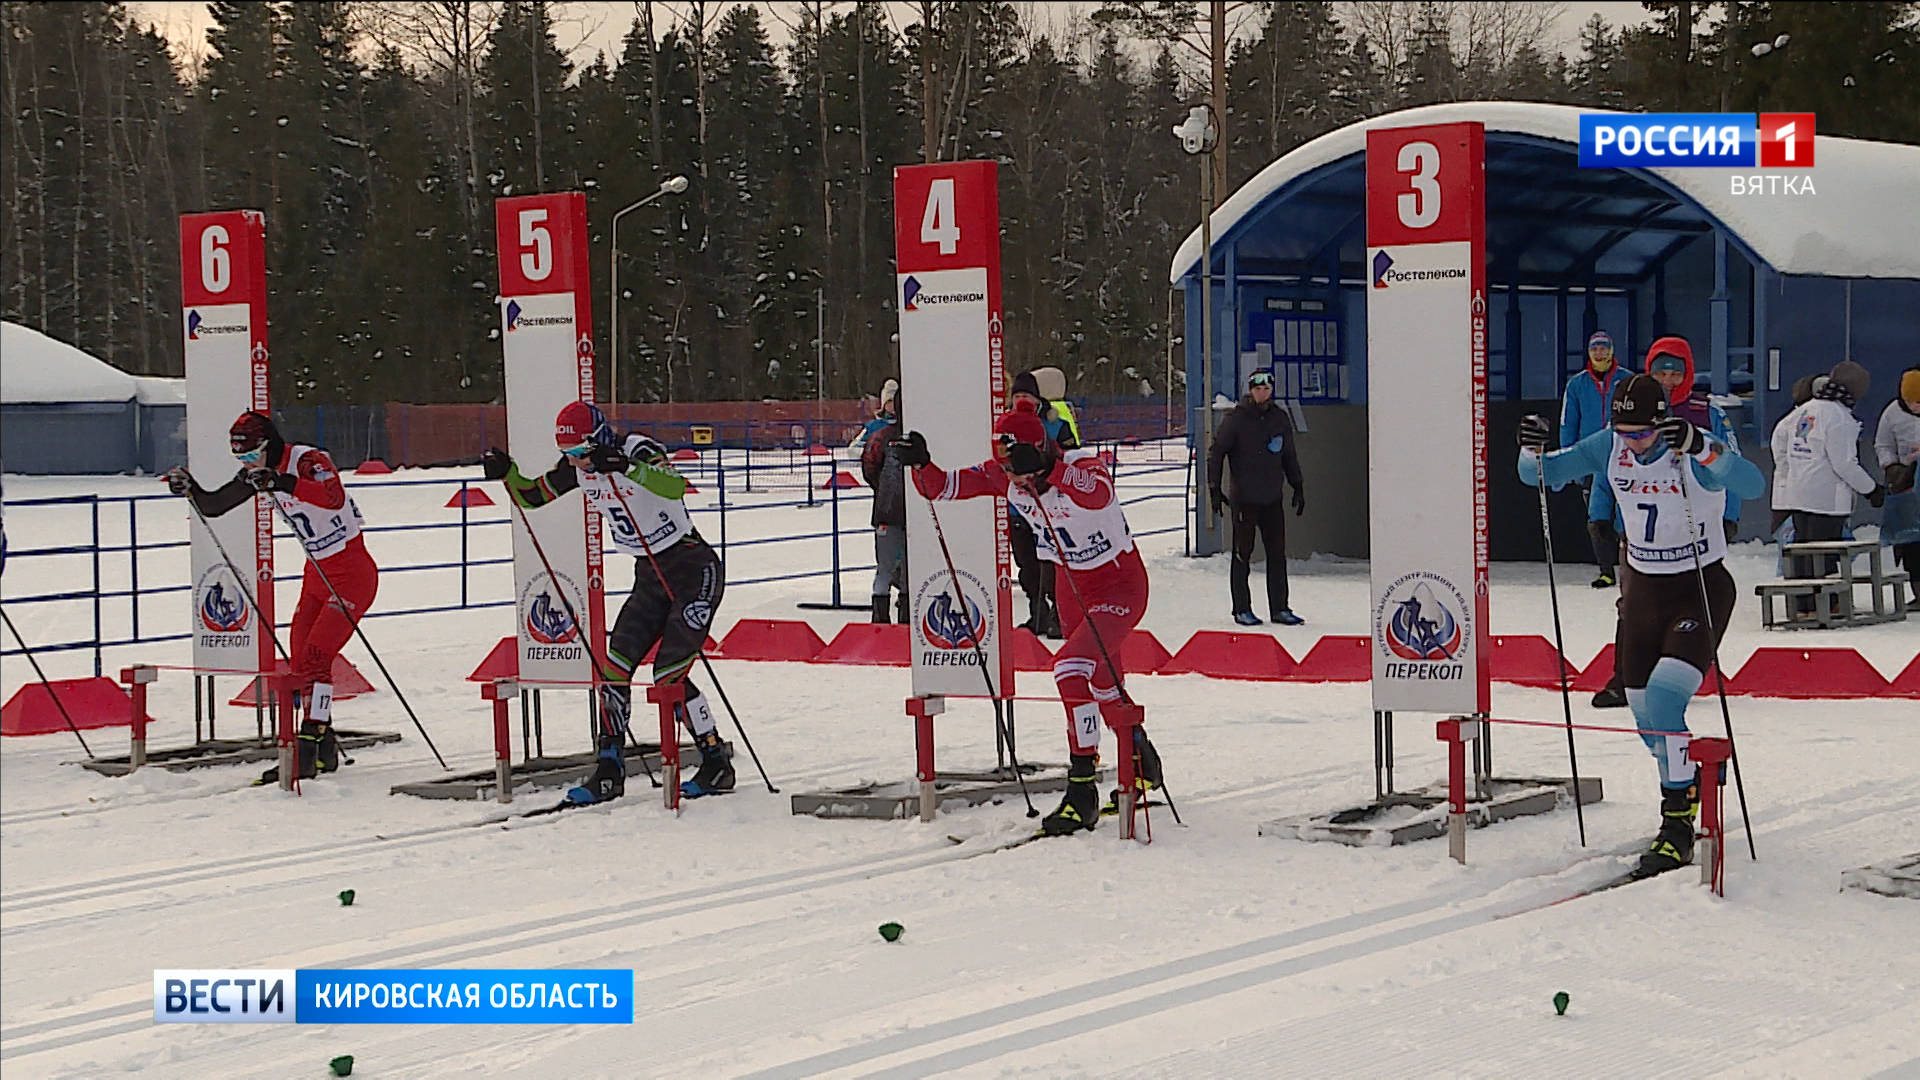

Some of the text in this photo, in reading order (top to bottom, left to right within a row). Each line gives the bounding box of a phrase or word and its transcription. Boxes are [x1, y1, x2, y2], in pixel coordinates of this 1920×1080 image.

[1397, 141, 1441, 229] 3
[921, 178, 960, 255] 4
[519, 208, 553, 281] 5
[201, 225, 230, 294] 6
[1387, 268, 1466, 282] Ростелеком
[916, 292, 984, 305] Ростелеком
[197, 324, 248, 335] Ростелеком
[516, 316, 573, 328] Ростелеком
[1473, 317, 1487, 568] КИРОВВТОРЧЕРМЕТ ПЛЮС
[608, 507, 635, 536] 5
[1637, 503, 1658, 542] 7
[1088, 530, 1104, 544] 21
[201, 635, 250, 648] ПЕРЕКОП
[527, 647, 582, 660] ПЕРЕКОП
[923, 651, 988, 667] ПЕРЕКОП
[1385, 663, 1463, 680] ПЕРЕКОП
[319, 695, 331, 710] 17
[699, 705, 709, 721] 5
[1083, 715, 1097, 734] 21
